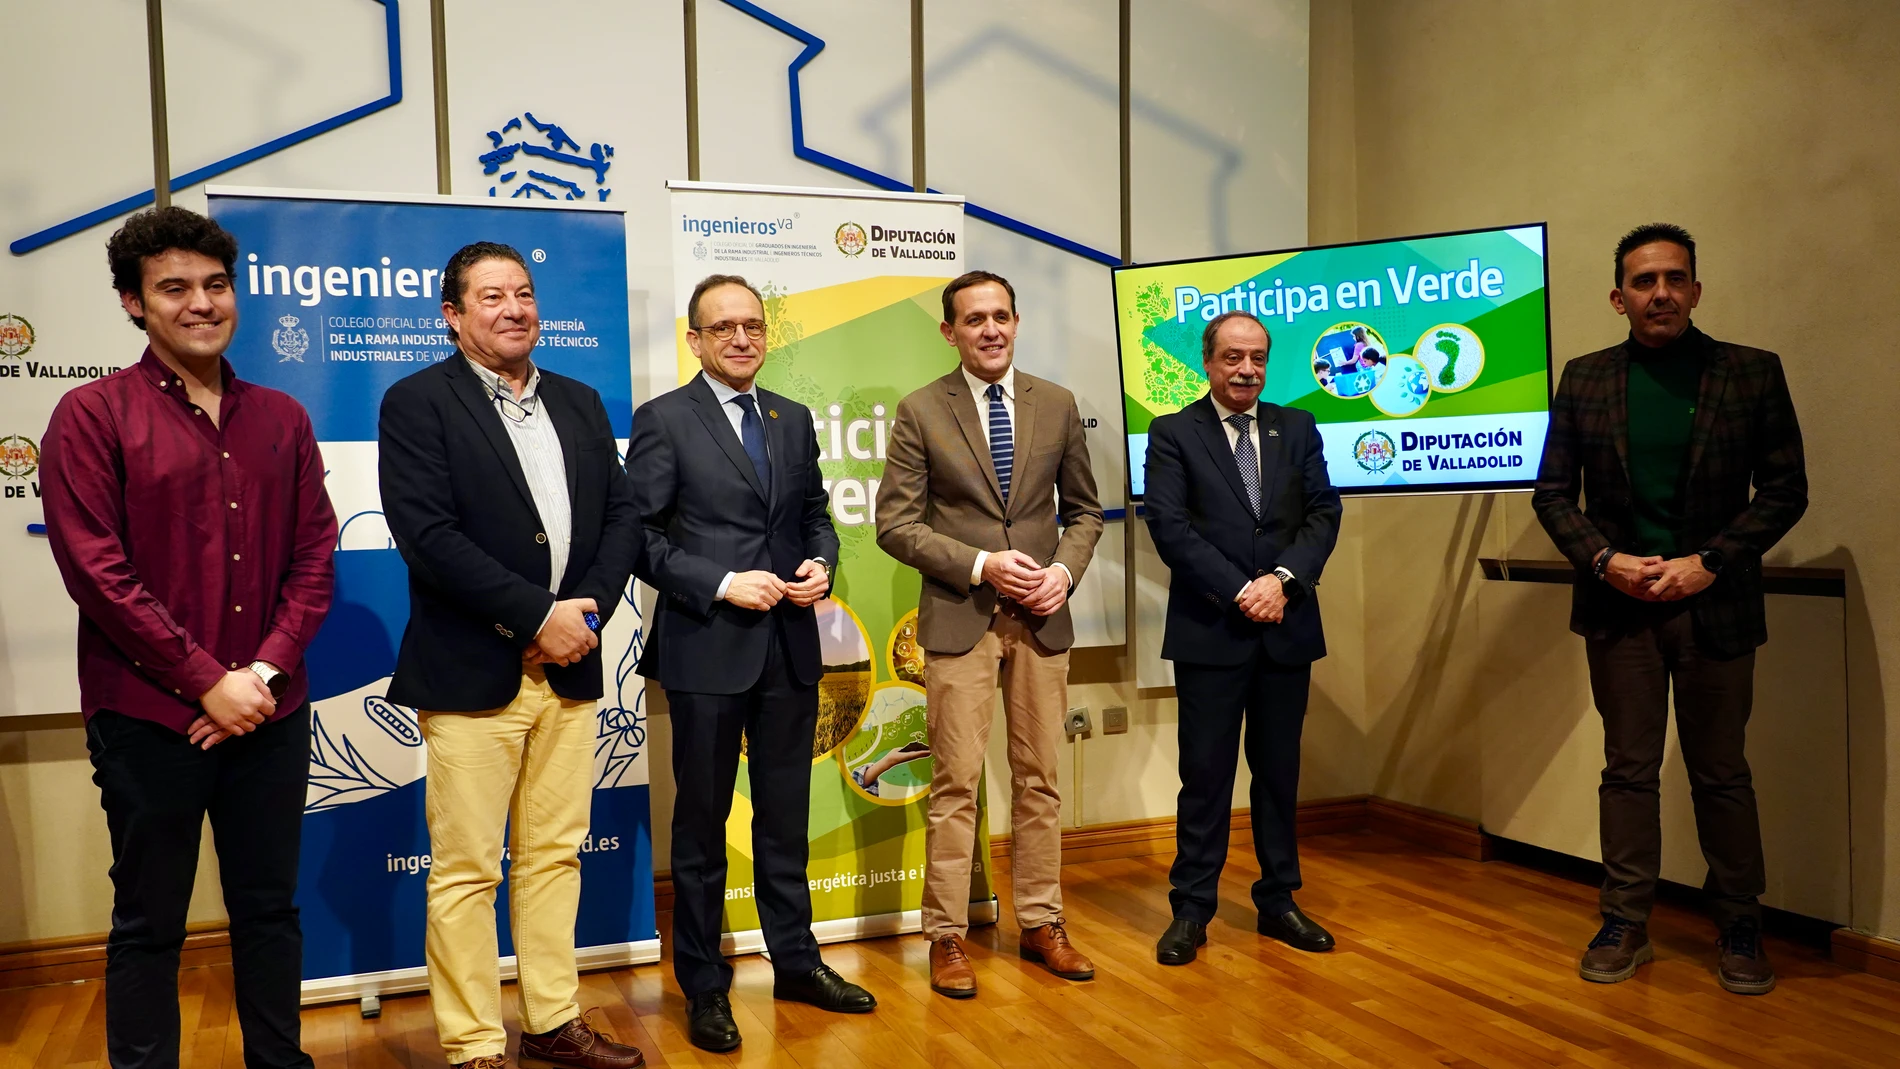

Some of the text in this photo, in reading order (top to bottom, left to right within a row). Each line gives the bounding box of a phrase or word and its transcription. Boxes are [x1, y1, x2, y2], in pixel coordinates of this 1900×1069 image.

[871, 225, 955, 244] DIPUTACIÓN
[872, 246, 956, 260] DE VALLADOLID
[247, 253, 446, 307] ingenier
[1175, 258, 1504, 323] Participa en Verde
[329, 316, 374, 328] COLEGIO
[377, 317, 416, 329] OFICIAL
[418, 318, 432, 329] DE
[330, 334, 345, 344] DE
[348, 334, 363, 345] LA
[365, 334, 399, 345] RAMA
[547, 334, 599, 348] TÉCNICOS
[330, 350, 414, 361] INDUSTRIALES
[416, 351, 430, 361] DE
[0, 365, 20, 377] DE
[1401, 428, 1522, 451] DIPUTACIÓN
[1402, 455, 1523, 471] DE VALLADOLID
[5, 486, 25, 498] DE
[809, 872, 867, 893] ergética
[869, 869, 906, 888] justa
[909, 868, 917, 880] e
